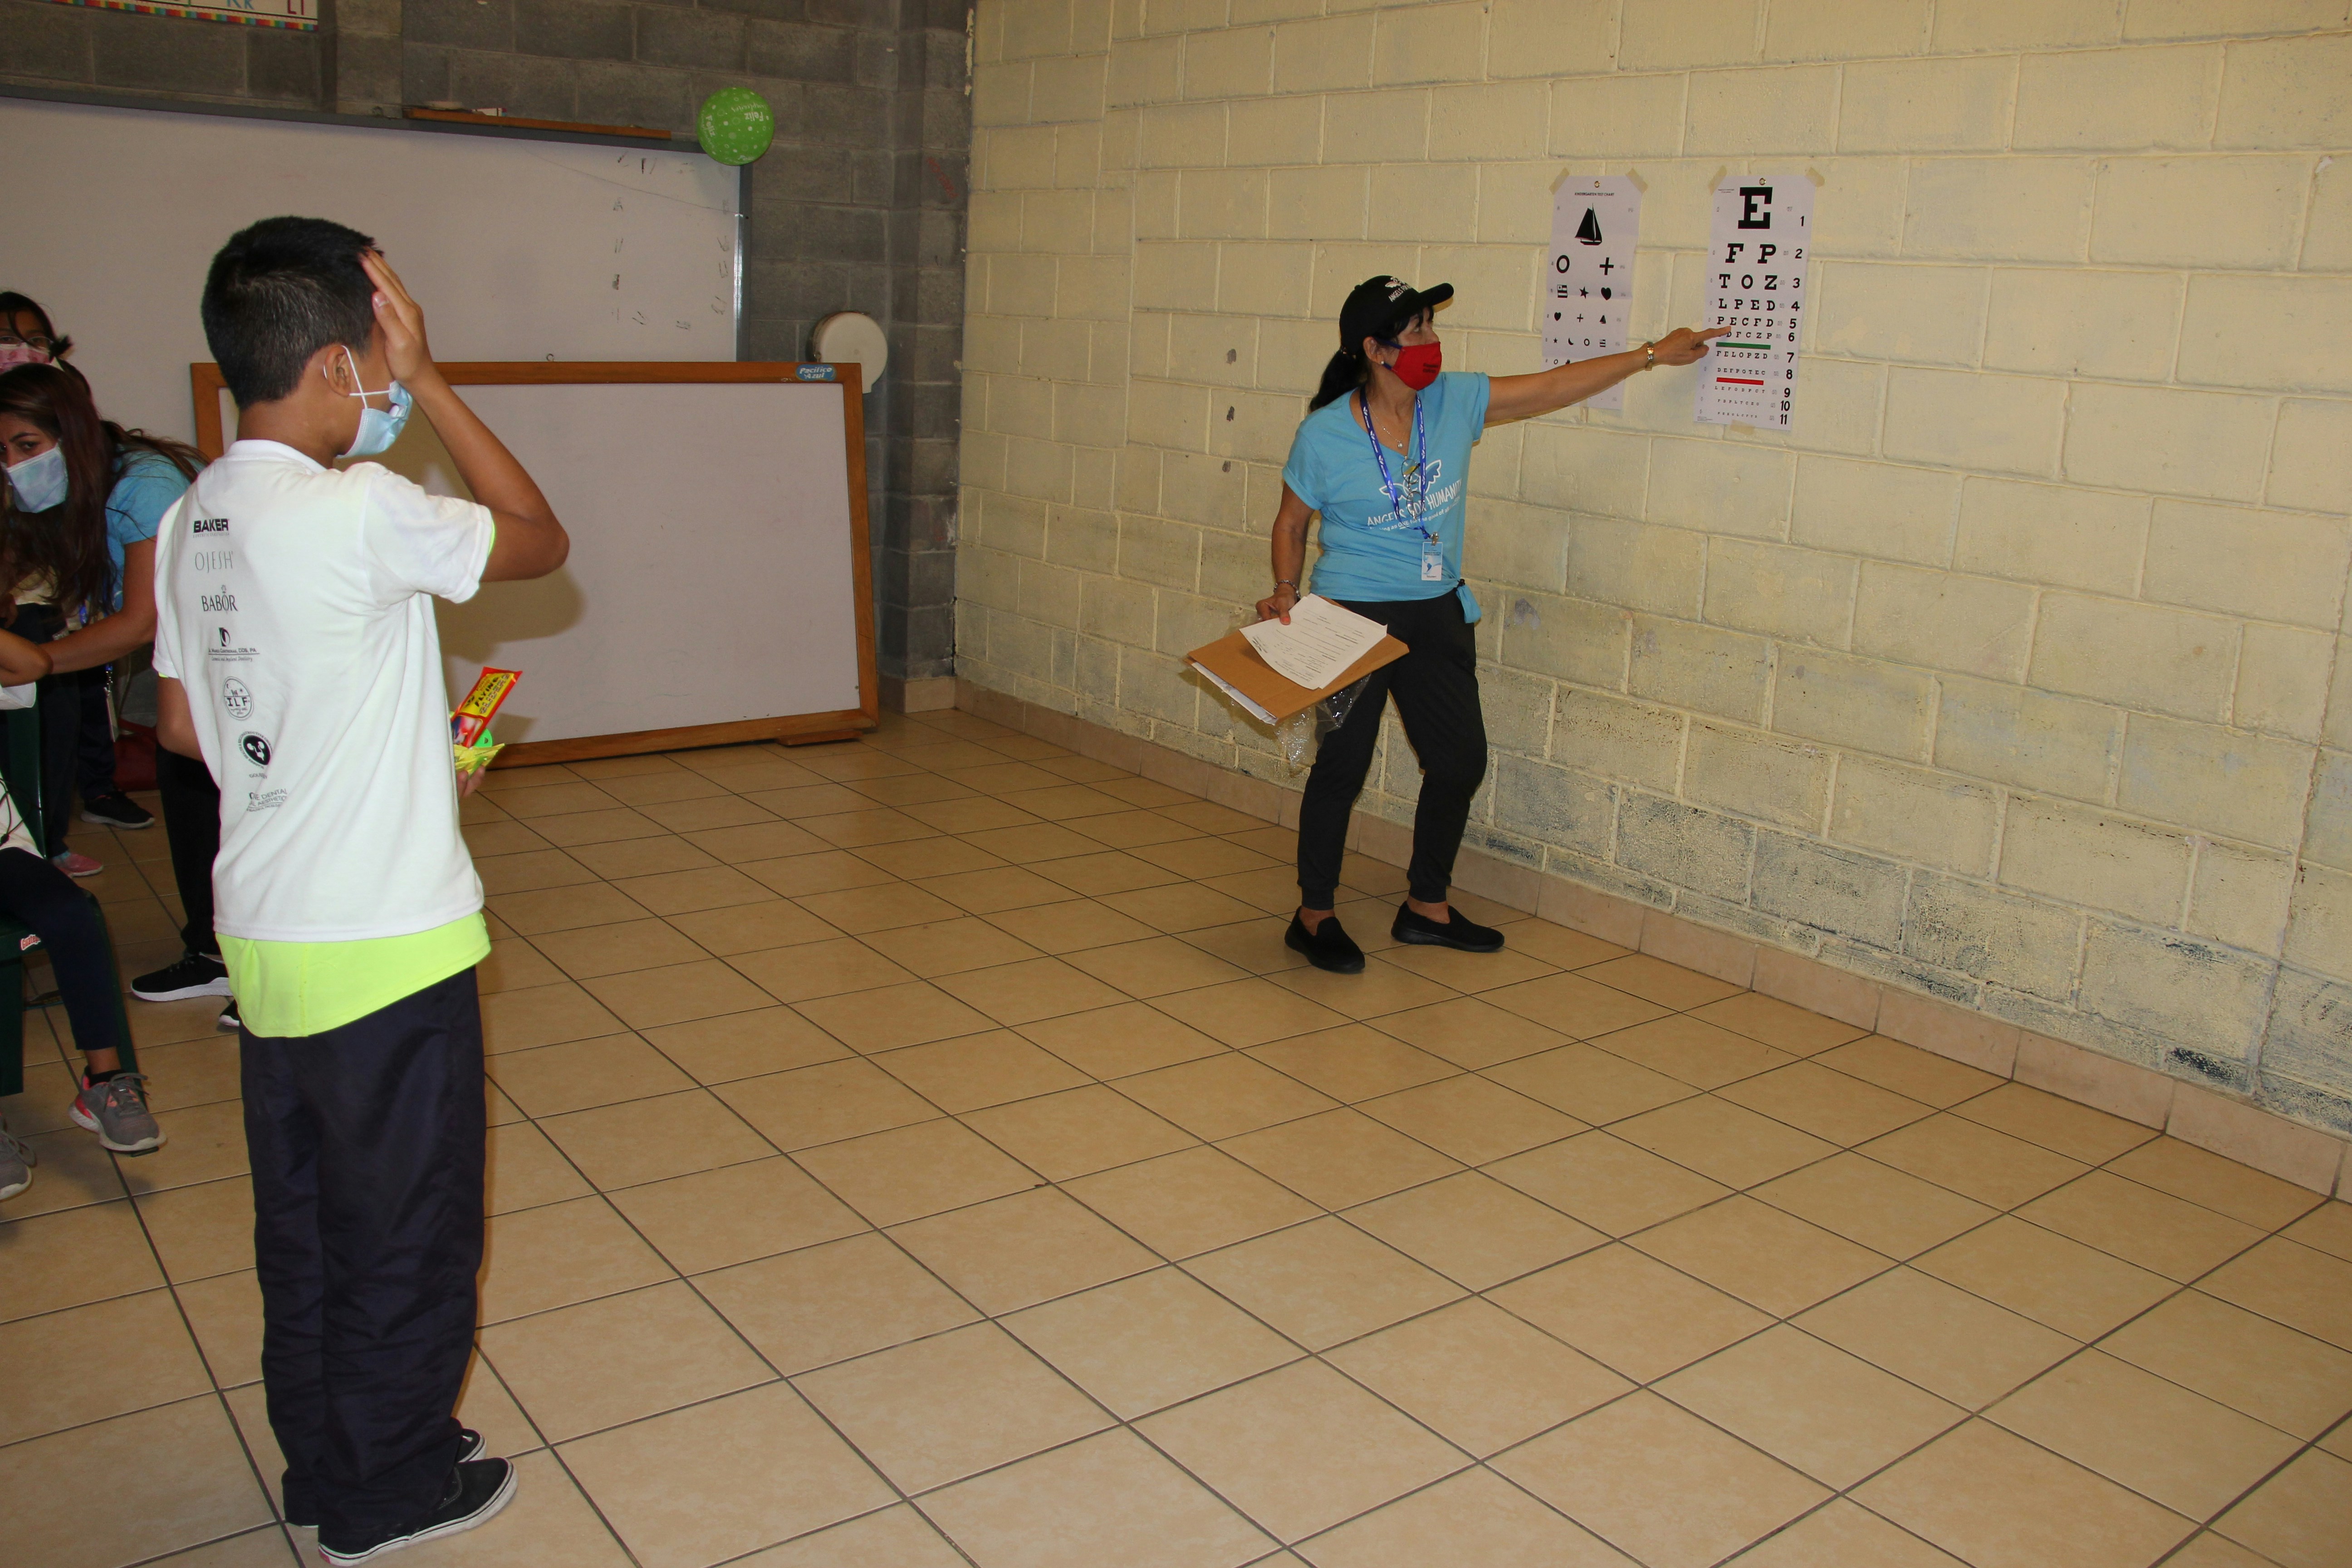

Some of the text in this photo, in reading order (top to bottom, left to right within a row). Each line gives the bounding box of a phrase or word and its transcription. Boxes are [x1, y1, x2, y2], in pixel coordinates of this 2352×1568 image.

[744, 112, 764, 122] Feliz
[1738, 187, 1804, 229] E 1
[1795, 248, 1803, 259] 2
[1793, 278, 1800, 288] 3
[1791, 301, 1800, 312] 4
[1789, 318, 1797, 329] 5
[1788, 332, 1794, 342] 6
[1787, 352, 1794, 363] 7
[1786, 369, 1793, 379] 8
[1784, 387, 1790, 397] 9
[1780, 400, 1790, 411] 10
[1780, 414, 1788, 425] 11
[194, 519, 228, 533] BAKER
[201, 595, 238, 611] BABOR
[261, 788, 288, 799] DENTAL
